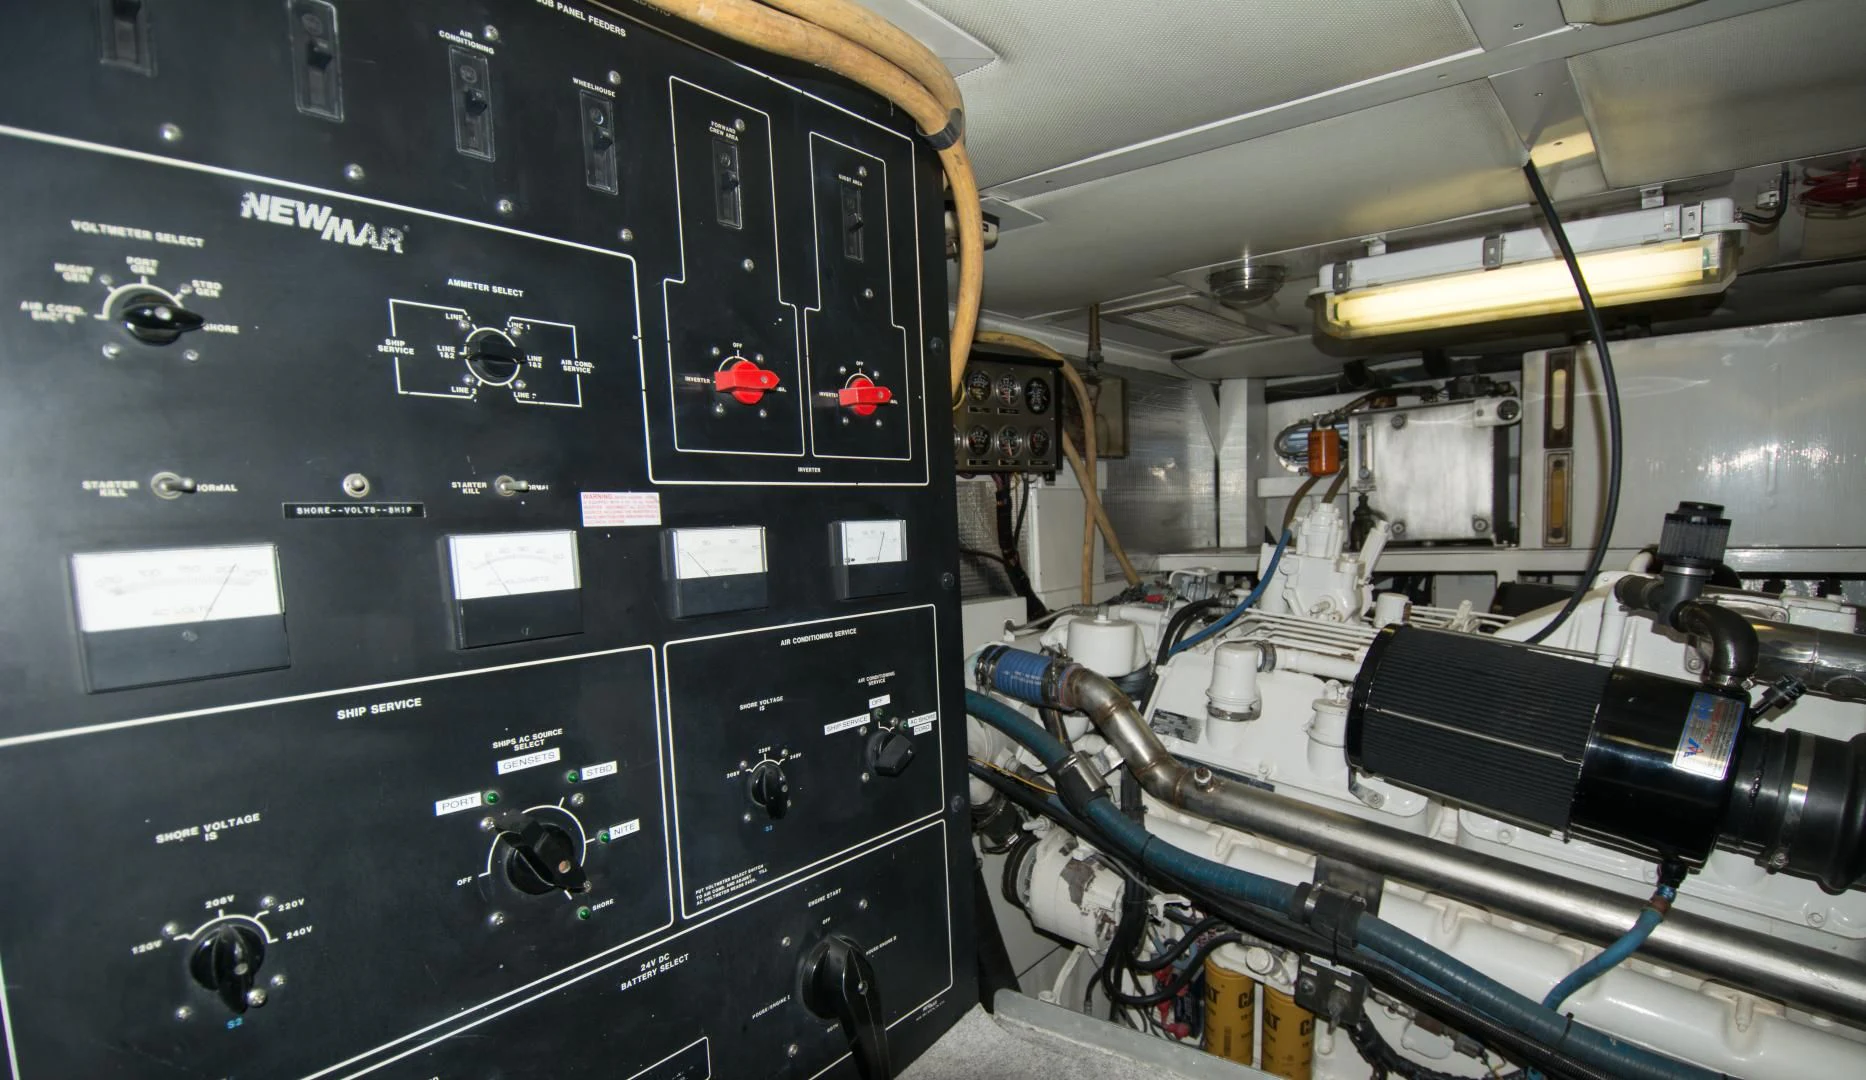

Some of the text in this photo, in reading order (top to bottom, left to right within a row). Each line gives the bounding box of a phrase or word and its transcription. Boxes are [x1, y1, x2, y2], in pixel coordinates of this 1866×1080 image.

[557, 2, 586, 20] PANEL
[588, 15, 626, 37] FEEDERS
[459, 30, 472, 39] AIR
[439, 30, 495, 54] CONDITIONING
[572, 76, 616, 98] WHEELHOUSE
[709, 127, 724, 136] CREW
[711, 121, 736, 134] FORWARD
[241, 192, 403, 254] NEWMAR
[71, 220, 204, 248] VOLTMETER SELECT
[126, 256, 158, 267] PORT
[130, 264, 157, 275] GEN
[447, 279, 524, 297] AMMETER SELECT
[21, 301, 43, 310] AIR
[378, 344, 414, 355] SERVICE
[563, 366, 591, 374] SERVICE
[685, 376, 711, 384] INVERTER
[82, 480, 138, 490] STARTER
[197, 484, 237, 492] ORMAL
[100, 489, 127, 497] KILL
[780, 628, 857, 646] AIR CONDITIONING SERVICE
[337, 697, 422, 720] SHIP SERVICE
[740, 696, 784, 710] SHORE VOLTAGE
[842, 716, 868, 726] SERVICE
[492, 728, 563, 749] SHIPS AC SOURCE
[513, 738, 545, 752] SELECT
[503, 751, 556, 770] GENSETS
[586, 764, 613, 777] STBD
[442, 796, 476, 811] PORT
[156, 812, 260, 844] SHORE VOLTAGE
[613, 823, 636, 836] NITE
[205, 832, 218, 842] IS
[456, 876, 472, 887] OFF
[205, 894, 235, 909] 208V
[278, 898, 305, 912] 220V
[591, 898, 614, 911] SHORE
[286, 926, 312, 940] 240V
[640, 952, 670, 972] 24V DC
[621, 954, 689, 991] BATTERY SELECT
